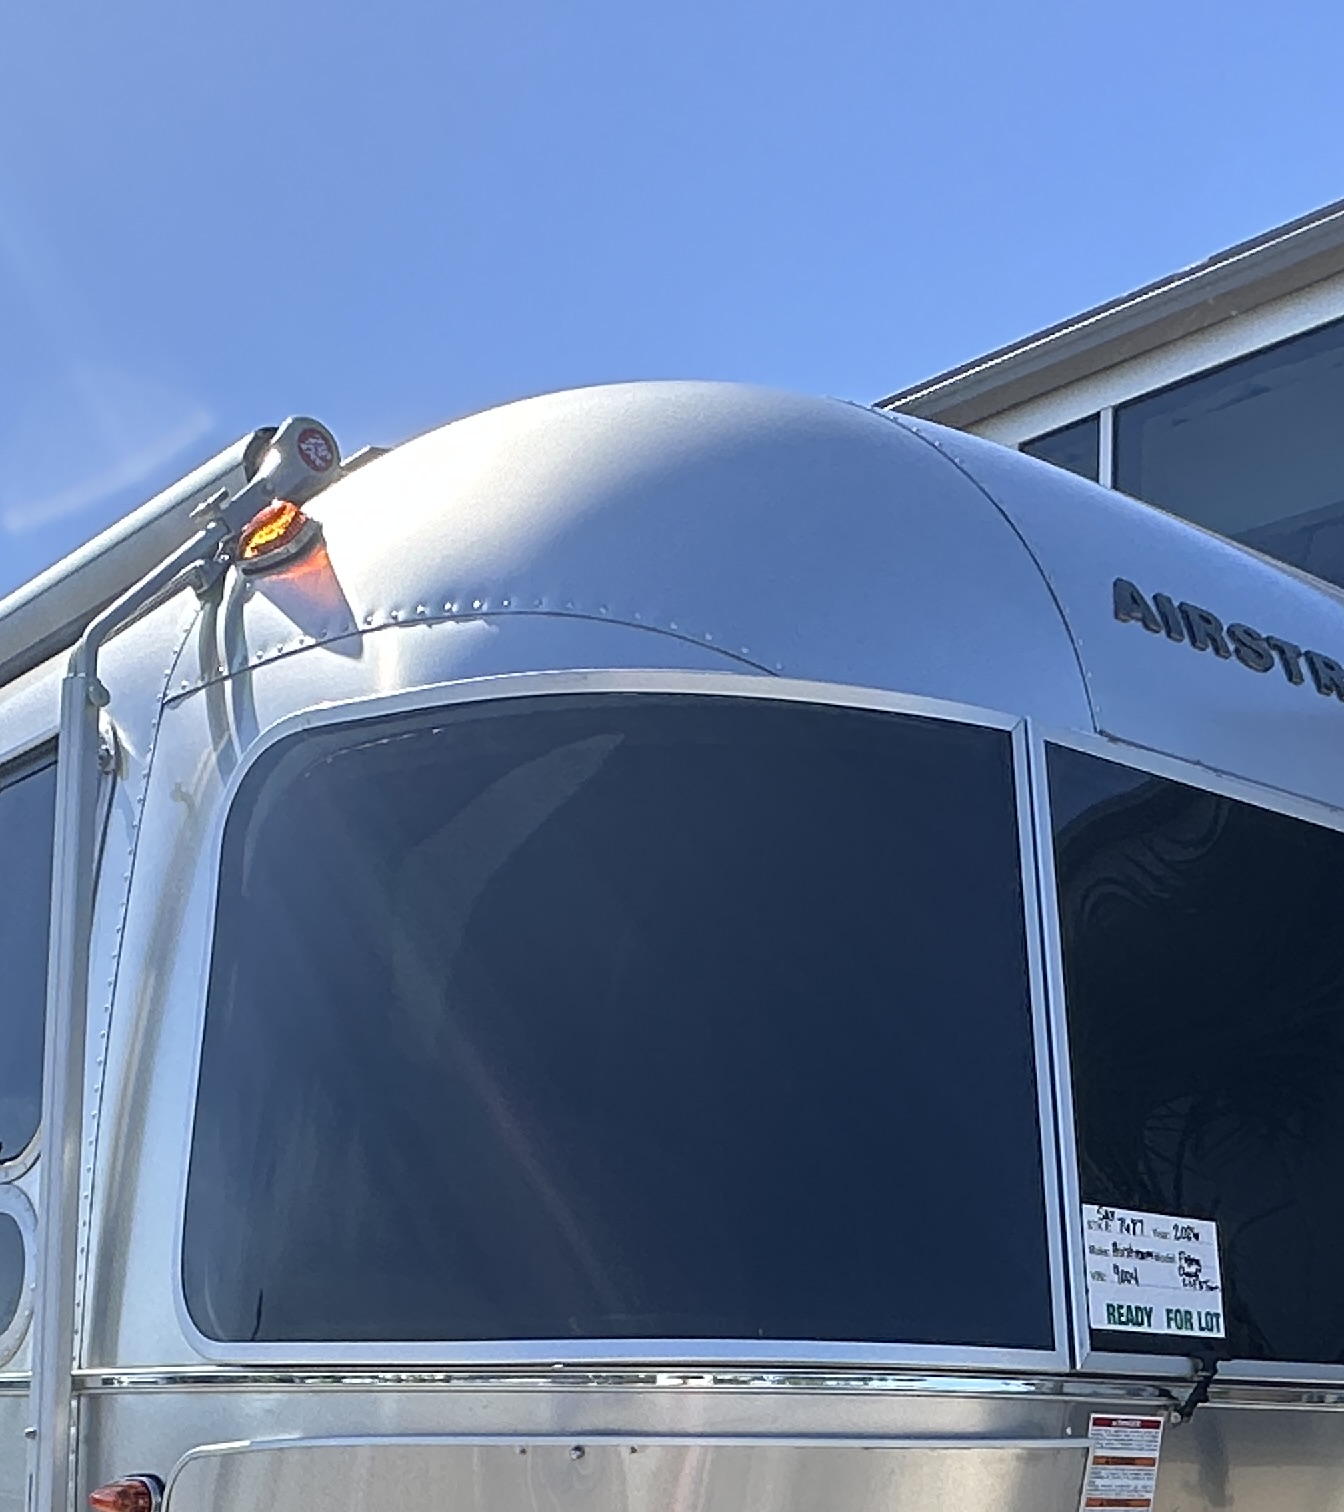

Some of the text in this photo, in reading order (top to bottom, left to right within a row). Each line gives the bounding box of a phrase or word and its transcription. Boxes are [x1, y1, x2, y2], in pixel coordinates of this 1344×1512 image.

[1106, 1303, 1221, 1333] READY FOR LOT
